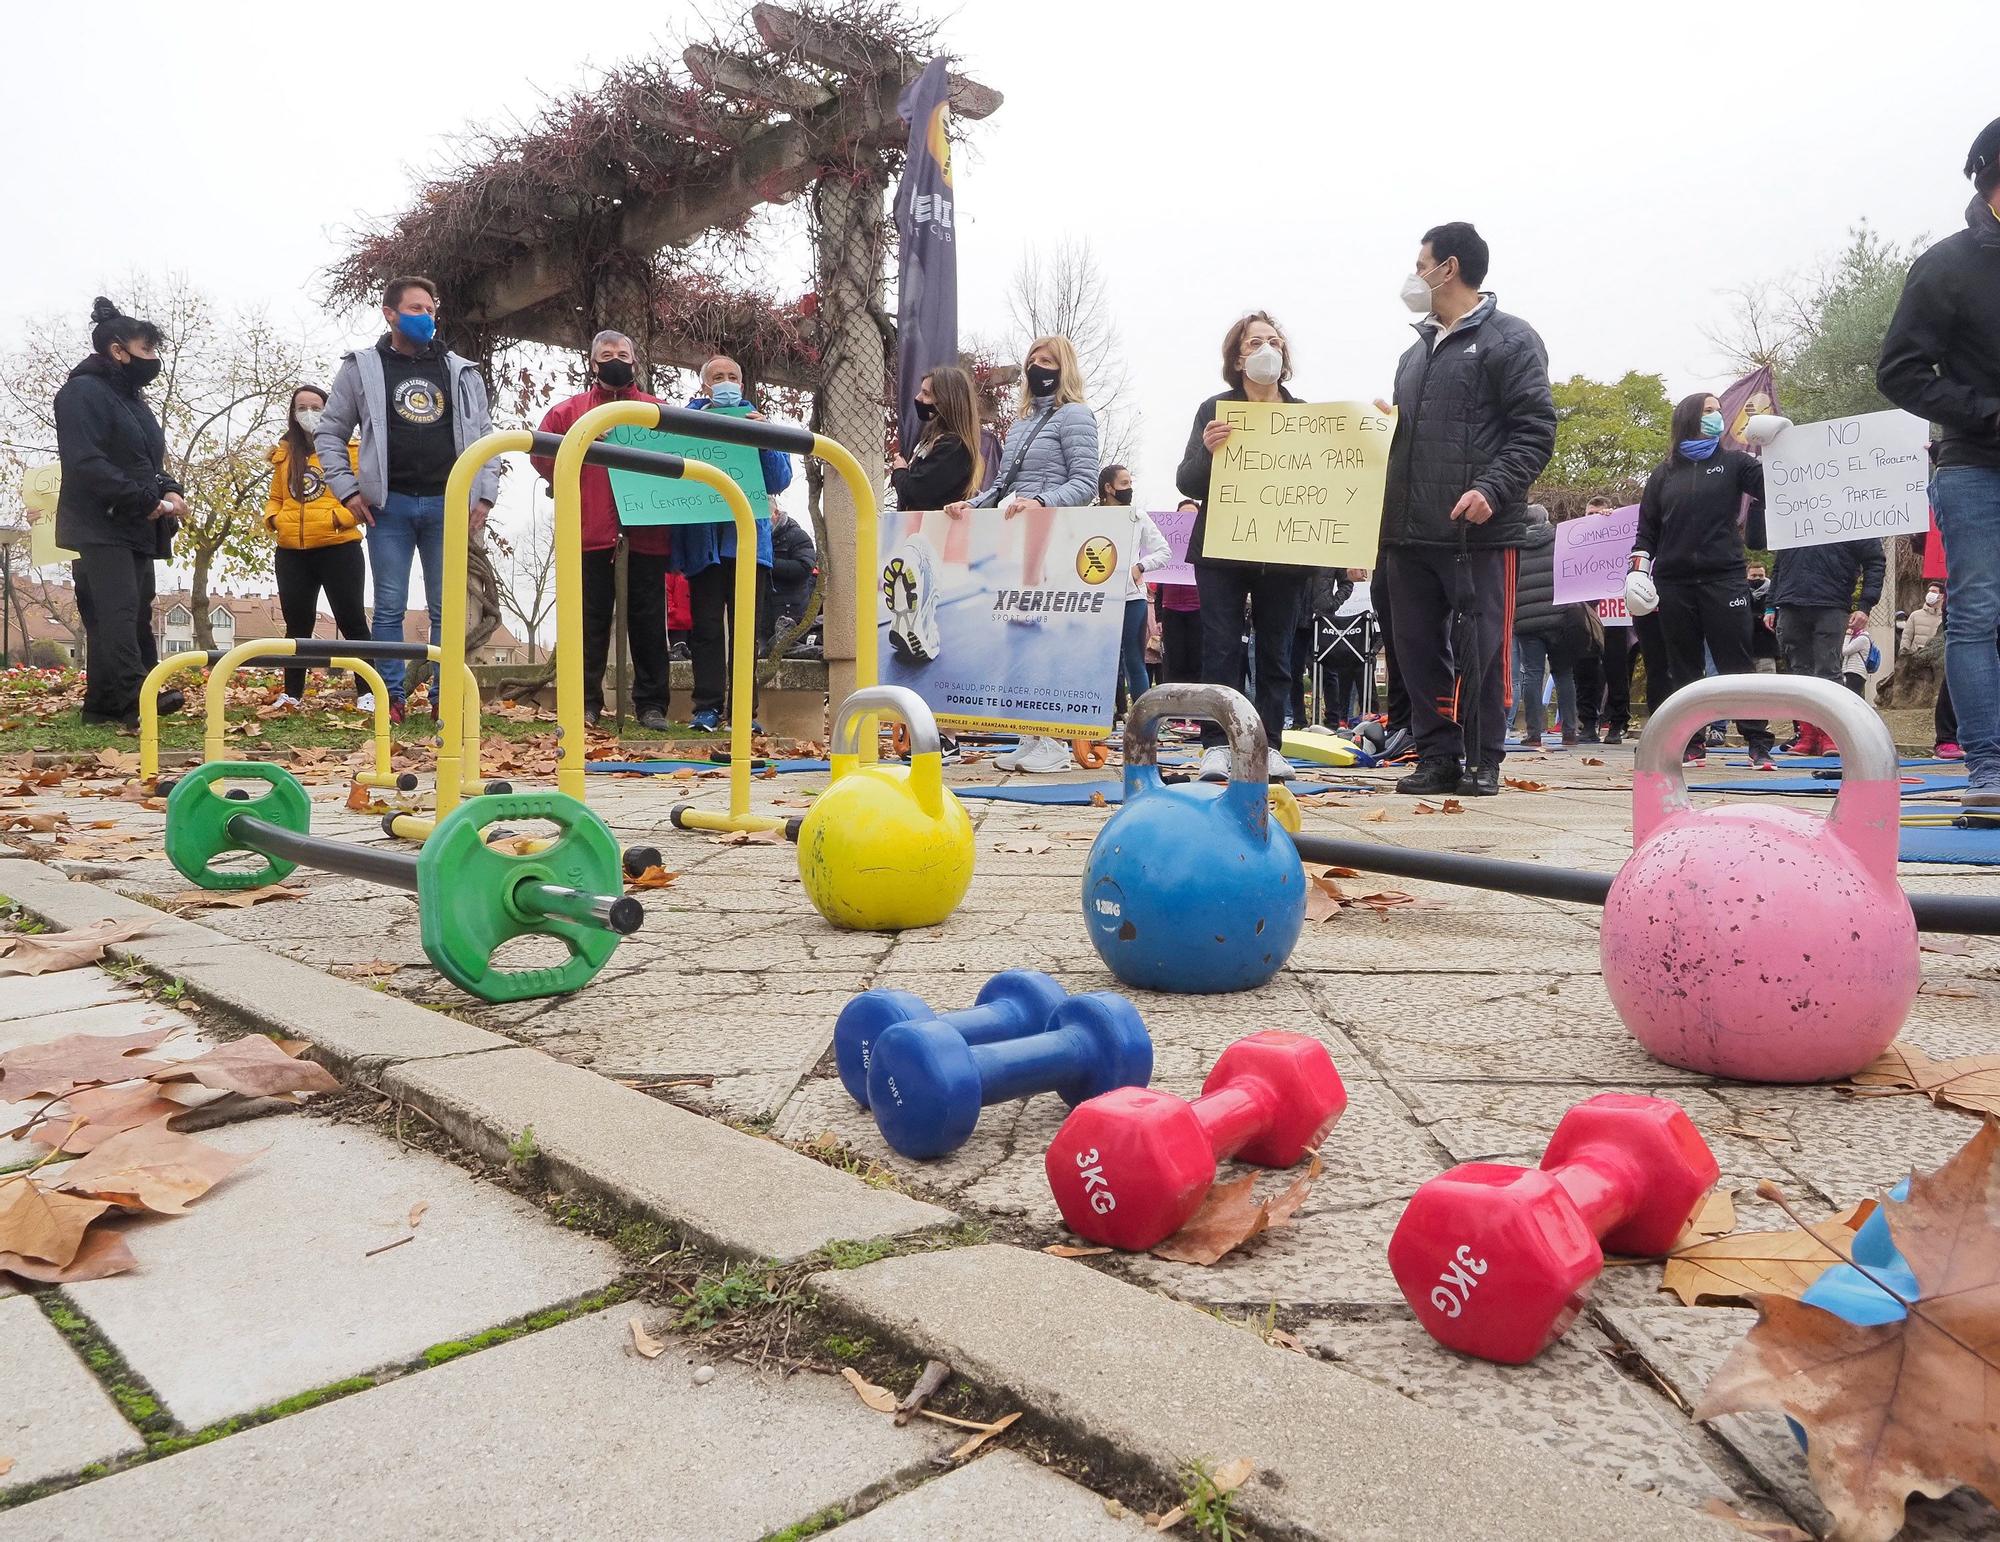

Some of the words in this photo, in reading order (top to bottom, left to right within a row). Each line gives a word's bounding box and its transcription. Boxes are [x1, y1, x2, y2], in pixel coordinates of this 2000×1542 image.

[1226, 411, 1256, 431] EL
[1271, 411, 1347, 434] DEPORTE
[1359, 415, 1390, 432] ES
[1828, 421, 1861, 447] NO
[1224, 445, 1312, 471] MEDICINA
[1320, 448, 1364, 469] PARA
[1771, 460, 1840, 486] SOMOS
[1848, 456, 1867, 471] EL
[624, 494, 644, 512] EN
[651, 489, 703, 511] CENTROS
[1219, 485, 1247, 504] EL
[1260, 485, 1328, 506] CUERPO
[1345, 487, 1359, 504] Y
[1775, 493, 1832, 516] SOMOS
[1842, 486, 1887, 503] PARTE
[1906, 481, 1926, 492] DE
[1231, 515, 1258, 543] LA
[1275, 517, 1350, 544] MENTE
[1795, 518, 1815, 539] LA
[1824, 502, 1911, 534] SOLUCIÓN
[993, 590, 1105, 613] XPERIENCE
[992, 614, 1020, 622] SPORT
[1025, 615, 1048, 623] CLUB
[934, 681, 950, 690] POR
[980, 684, 996, 693] POR
[1034, 687, 1051, 697] POR
[947, 695, 984, 706] PORQUE
[986, 697, 998, 707] TE
[1000, 698, 1013, 709] LO
[1015, 699, 1064, 713] MERECES,
[1067, 703, 1089, 714] POR
[1092, 705, 1101, 715] TI
[888, 1076, 903, 1107] 2.5KG
[1076, 1148, 1116, 1215] 3KG
[1430, 1244, 1488, 1318] 3KG
